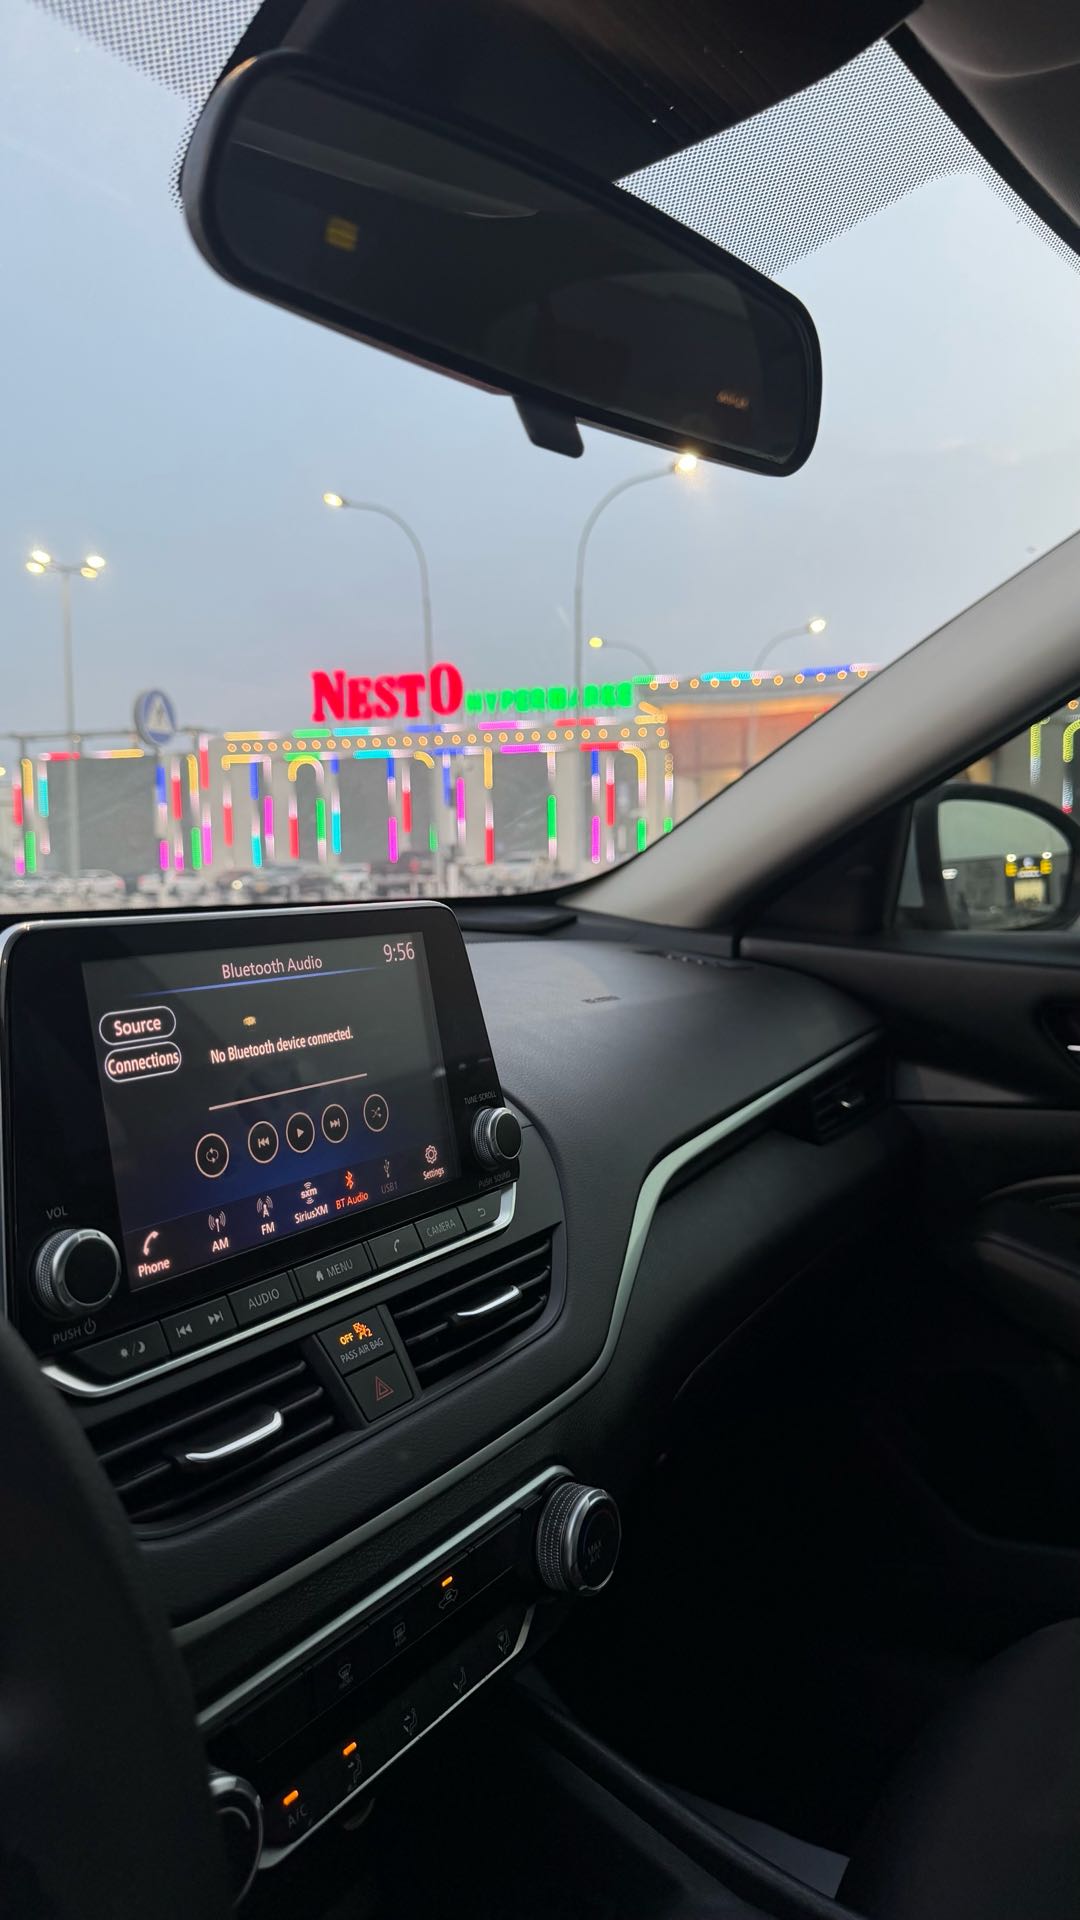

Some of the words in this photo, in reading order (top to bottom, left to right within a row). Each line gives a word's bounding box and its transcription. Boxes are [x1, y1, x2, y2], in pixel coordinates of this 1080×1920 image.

[310, 662, 464, 722] NESTO
[382, 941, 416, 963] 9:56
[221, 957, 285, 979] Bluetooth
[287, 955, 323, 973] Audio
[113, 1016, 162, 1037] Source
[210, 1048, 226, 1065] No
[228, 1038, 275, 1062] Bluetooth
[276, 1034, 306, 1053] device
[307, 1026, 354, 1046] connected.
[107, 1050, 180, 1077] Connections
[422, 1166, 445, 1181] Settings
[300, 1187, 318, 1199] sxm
[380, 1182, 399, 1195] USB1
[335, 1197, 346, 1210] BT
[347, 1192, 369, 1206] Audio
[46, 1206, 69, 1220] VOL
[294, 1203, 329, 1224] SiriusXM
[261, 1221, 276, 1236] FM
[426, 1219, 456, 1237] CAMERA
[211, 1237, 230, 1252] AM
[137, 1258, 171, 1277] Phone
[326, 1260, 353, 1278] MENU
[248, 1288, 280, 1310] AUDIO
[52, 1326, 82, 1344] PUSH
[339, 1332, 354, 1345] OFF
[340, 1349, 358, 1364] PASS
[357, 1344, 370, 1356] AIR
[370, 1337, 384, 1349] BAG
